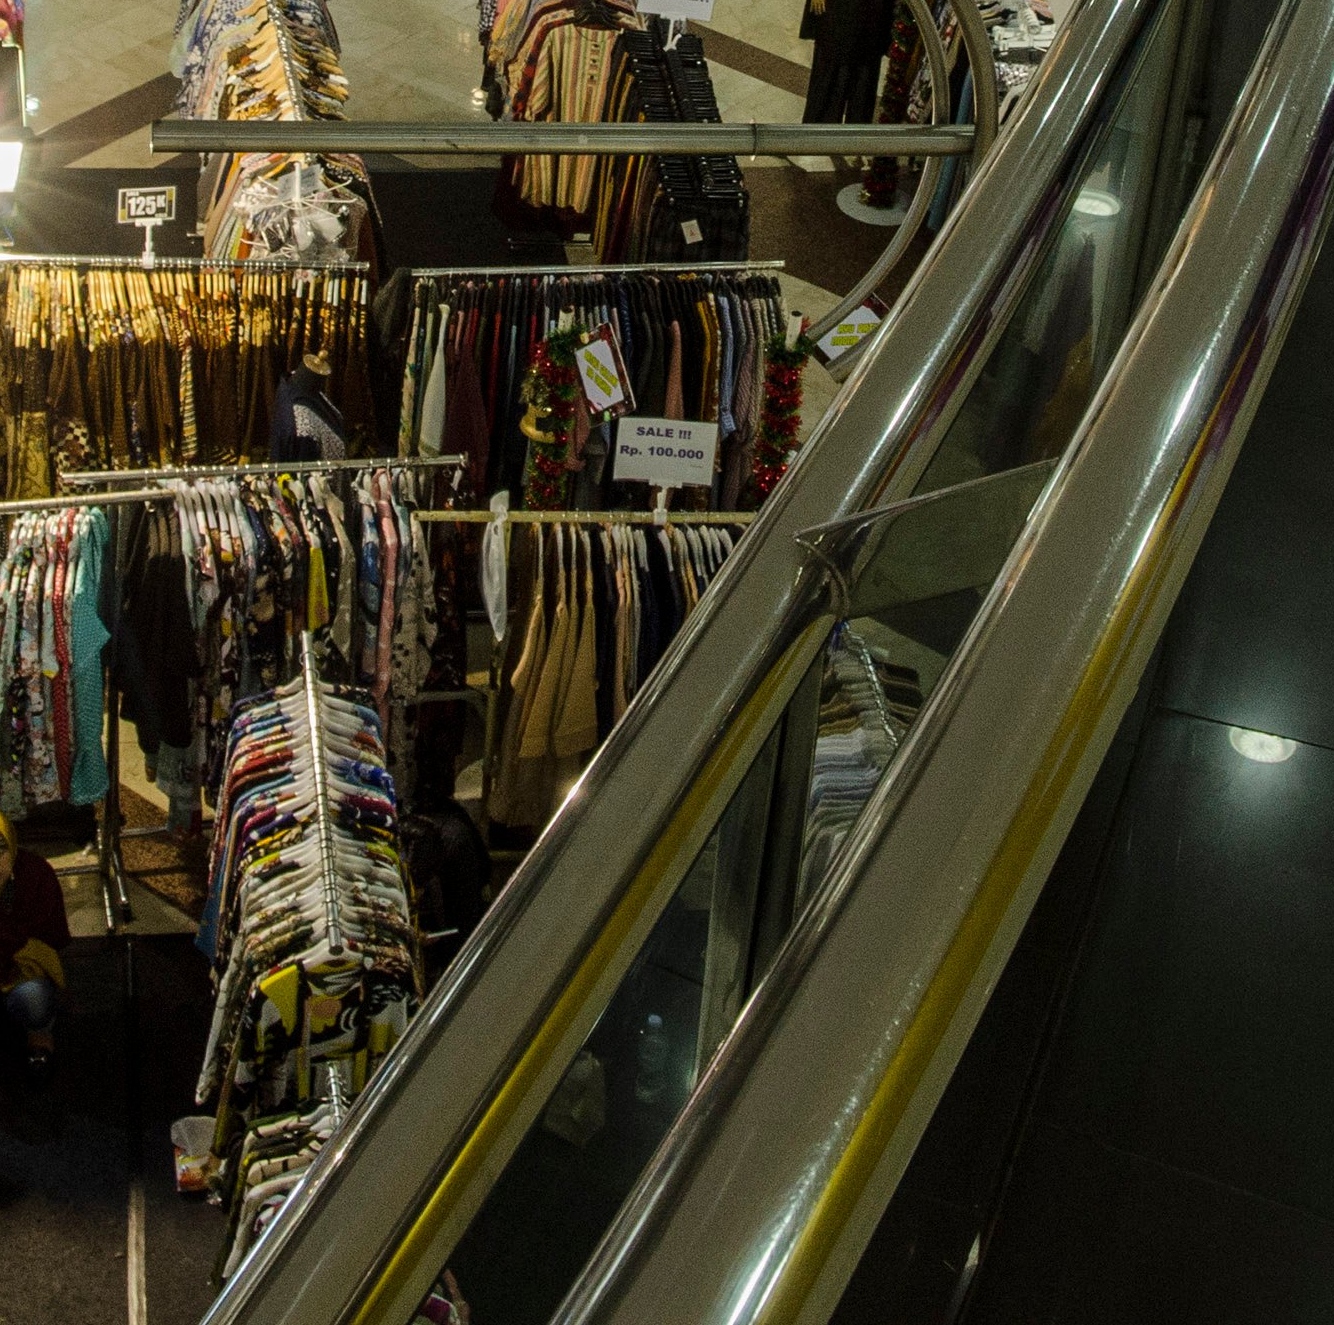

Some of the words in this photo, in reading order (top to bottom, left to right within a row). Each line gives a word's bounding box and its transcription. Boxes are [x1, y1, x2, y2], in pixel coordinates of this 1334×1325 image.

[128, 194, 166, 217] 125K
[636, 426, 674, 438] SALE
[678, 429, 692, 440] !!!
[619, 445, 643, 457] Rp.
[647, 446, 705, 460] 100.000
